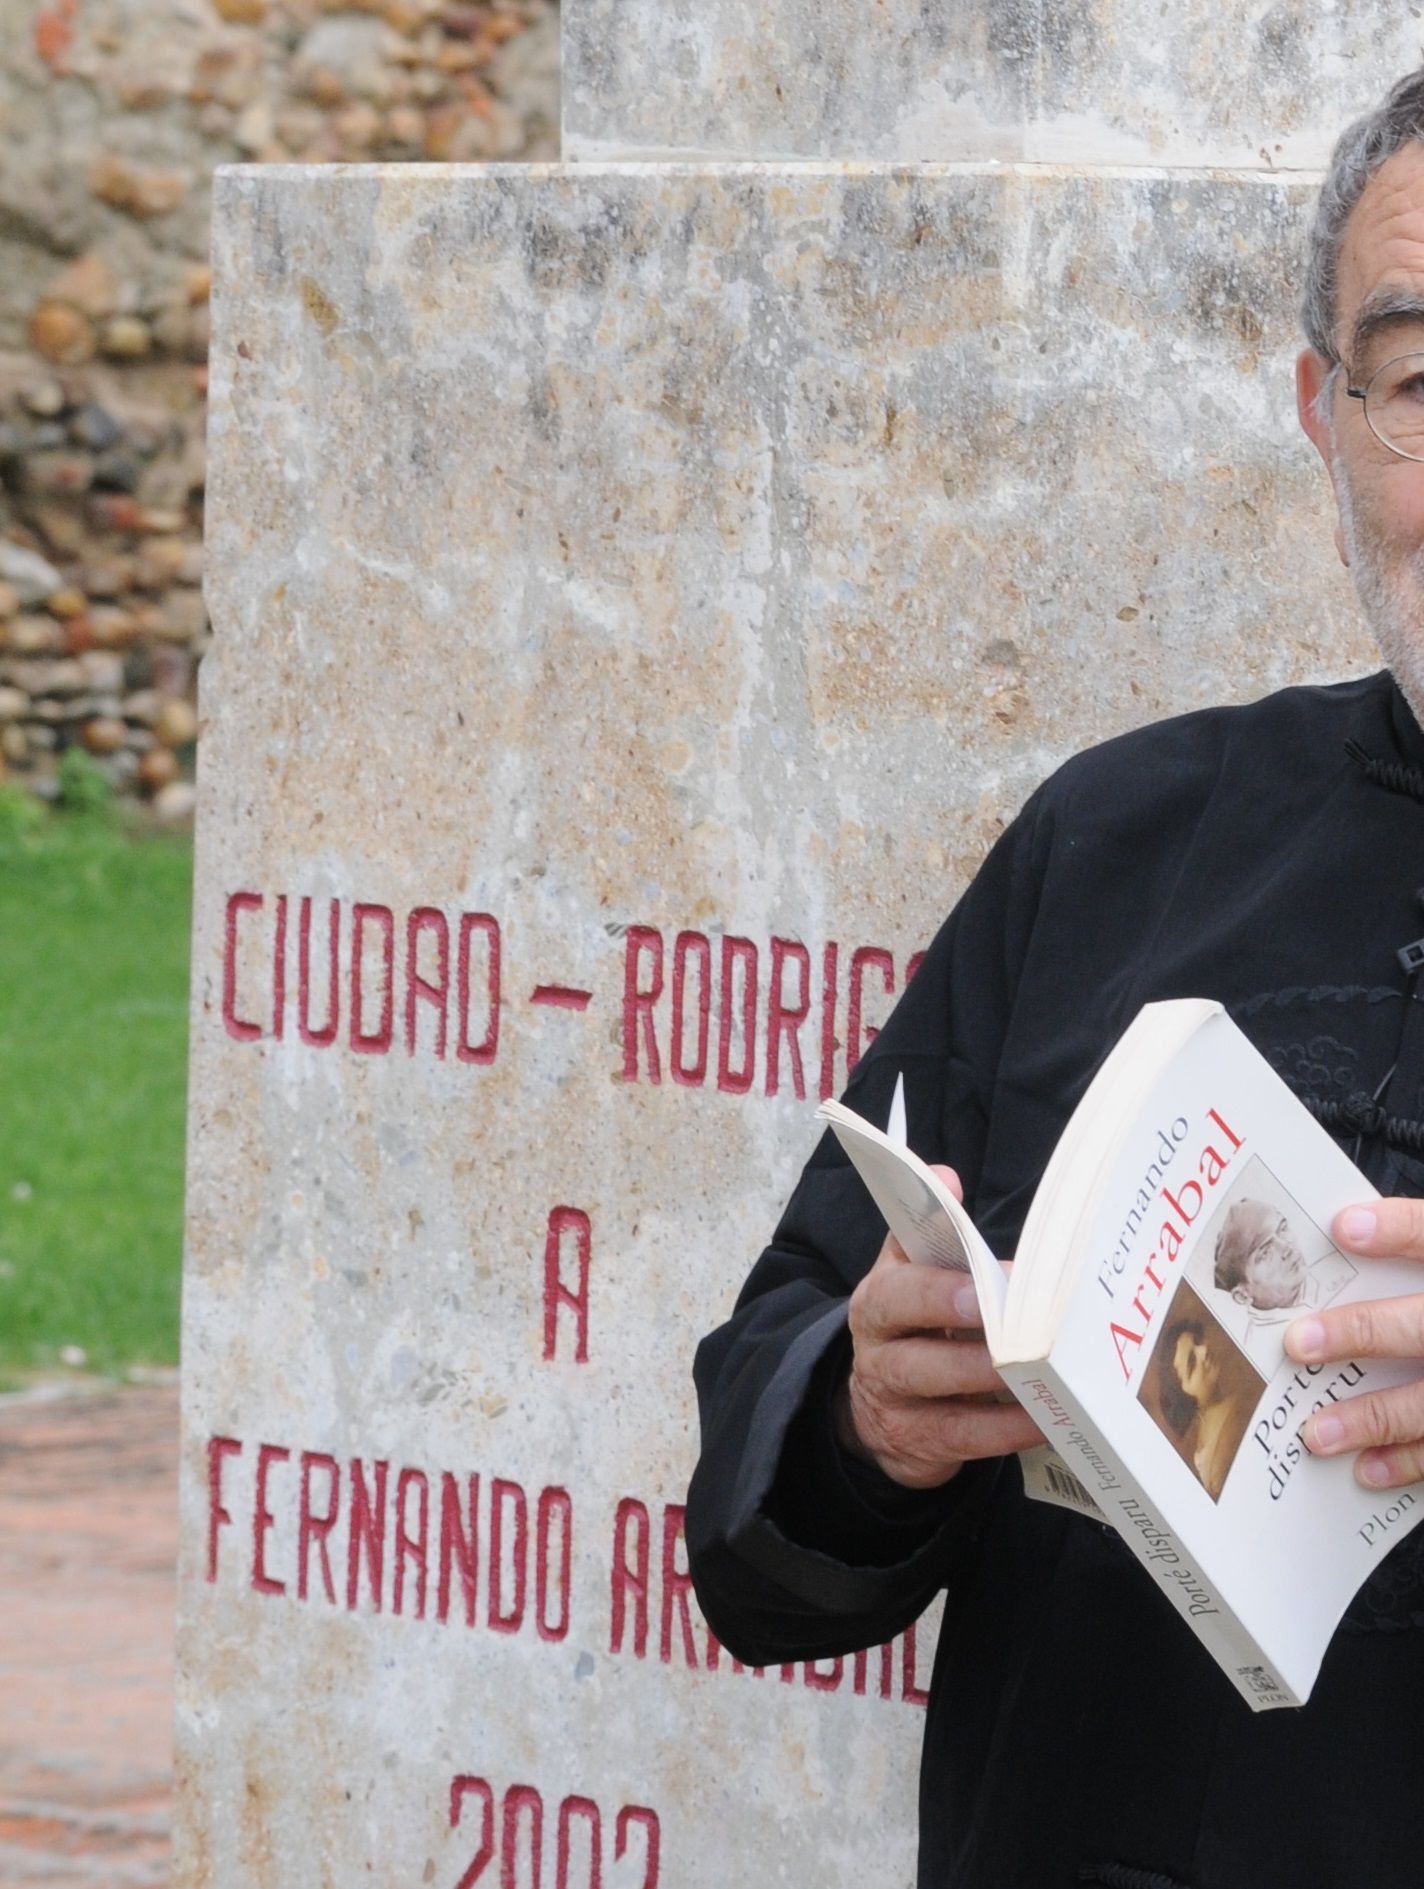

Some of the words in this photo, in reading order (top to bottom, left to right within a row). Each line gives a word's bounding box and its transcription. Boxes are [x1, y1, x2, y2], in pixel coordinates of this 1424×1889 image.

[221, 891, 502, 1066] CIUDAD
[621, 924, 929, 1104] RODRIG
[1097, 1116, 1190, 1299] Fernando
[1109, 1107, 1247, 1387] Arrabal
[542, 1204, 592, 1364] A
[1020, 1379, 1076, 1428] Arrabal
[1066, 1430, 1122, 1491] Fernando
[205, 1436, 573, 1643] FERNANDO
[1118, 1498, 1181, 1565] disparu
[1358, 1493, 1416, 1547] Plon
[1163, 1568, 1220, 1617] Porté
